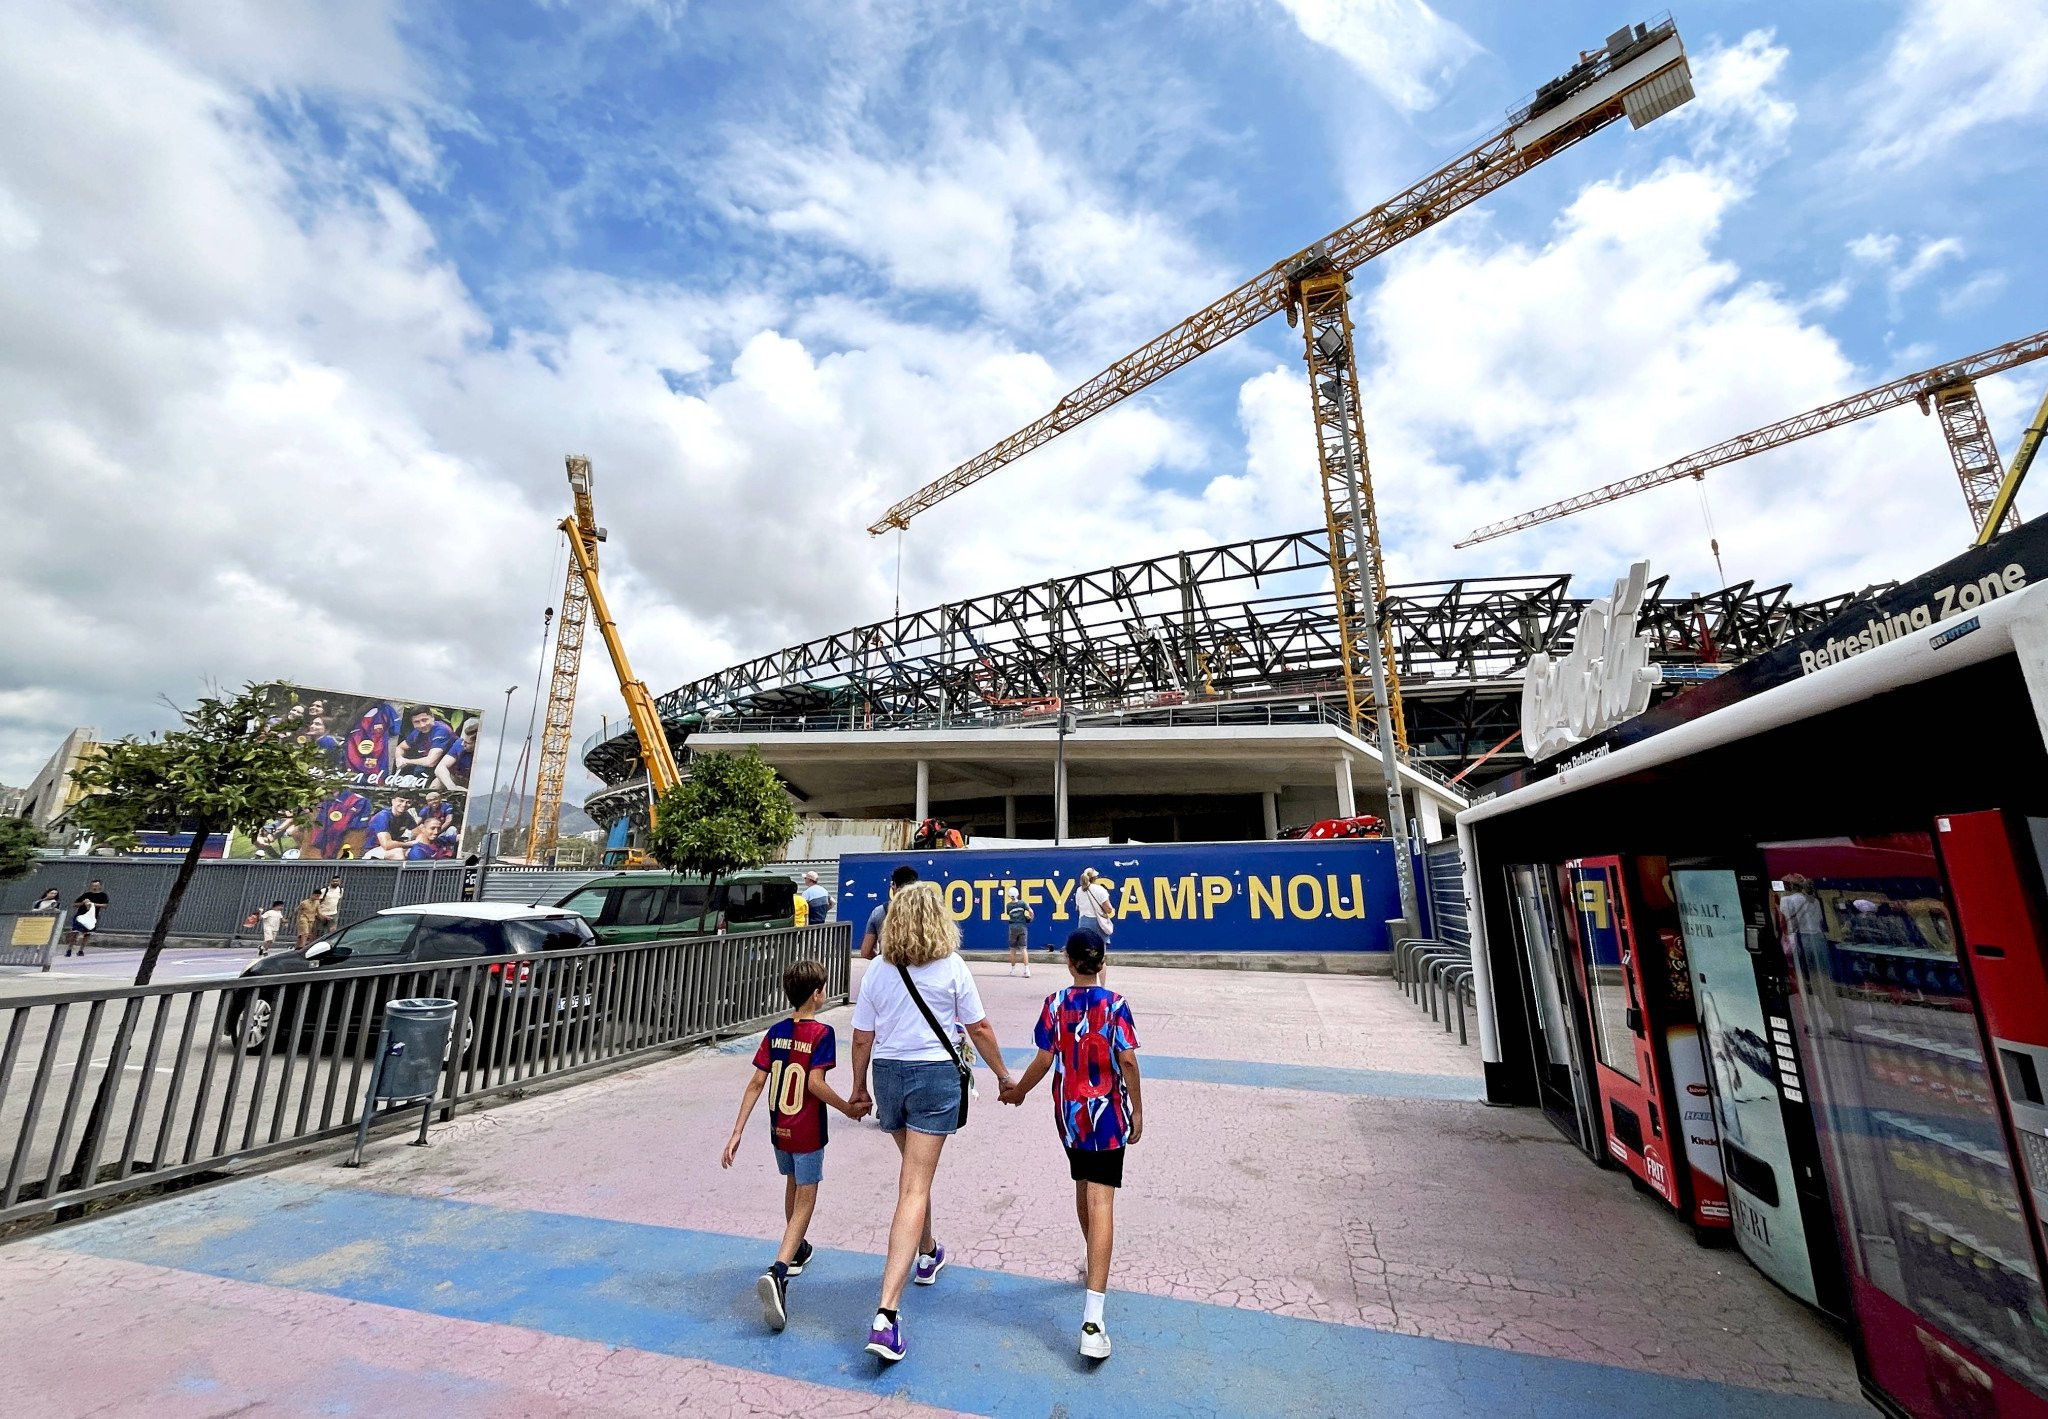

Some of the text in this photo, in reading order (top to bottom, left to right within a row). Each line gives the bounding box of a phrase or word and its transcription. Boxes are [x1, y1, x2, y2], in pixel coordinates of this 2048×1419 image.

[1800, 563, 2027, 675] Refreshing Zone
[367, 769, 384, 784] el
[1555, 762, 1572, 774] Zona
[144, 846, 159, 854] QUE
[1247, 874, 1366, 920] NOU
[769, 1059, 806, 1116] 10
[1646, 1156, 1665, 1184] FRIT
